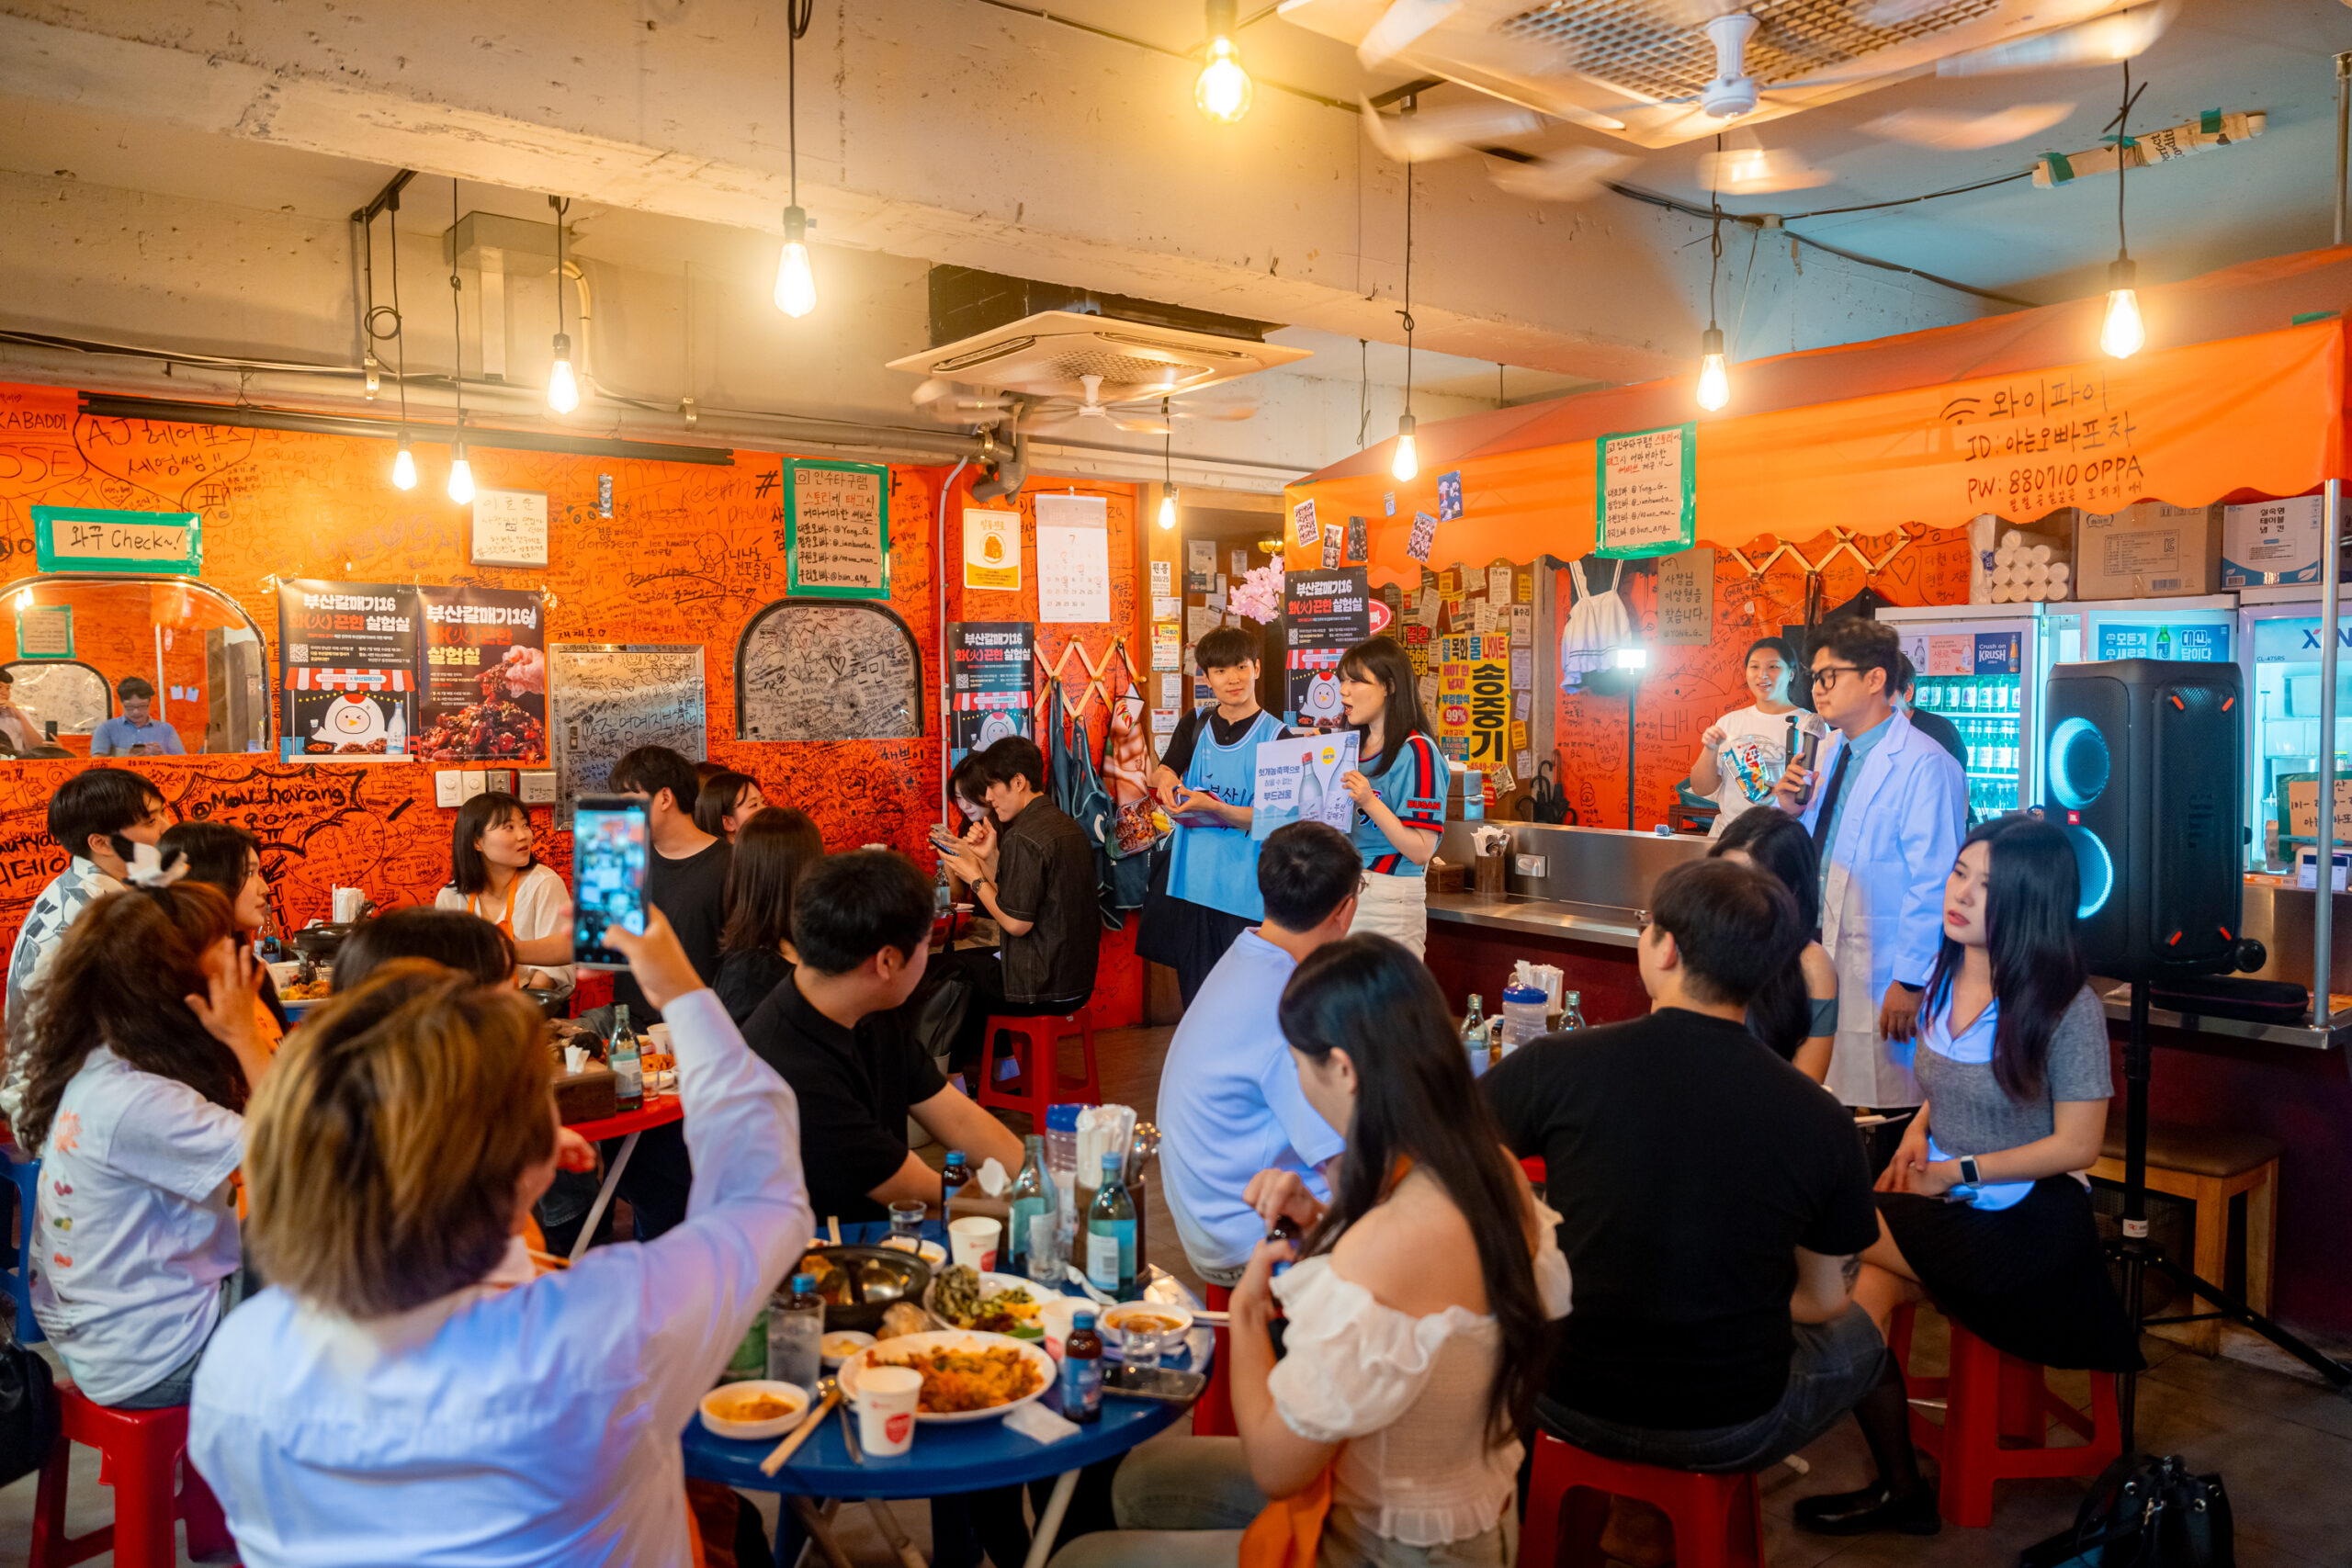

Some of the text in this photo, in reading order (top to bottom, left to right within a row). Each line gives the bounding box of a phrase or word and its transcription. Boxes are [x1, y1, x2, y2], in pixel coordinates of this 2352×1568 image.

[1989, 371, 2108, 418] 와이파이
[85, 418, 131, 448] AJ
[1965, 411, 2136, 461] ID: 아는오빠포차
[1968, 455, 2143, 504] PW: 880710 OPPA
[803, 491, 841, 507] 스토리에
[803, 508, 849, 521] 어마어마한
[735, 562, 772, 581] 전포술집
[1664, 571, 1694, 587] 사장님
[1296, 579, 1353, 597] 부산갈매기16
[303, 593, 397, 612] 부산갈매기16
[1332, 597, 1363, 613] 실험실
[366, 615, 411, 633] 실험실
[426, 604, 531, 626] 부산갈매기16
[1665, 606, 1703, 625] 찾습니다
[965, 633, 1023, 646] 부산갈매기16
[1482, 636, 1508, 661] 나이트
[2117, 633, 2147, 646] 모든게
[427, 647, 481, 665] 실험실
[1003, 648, 1031, 661] 실험실
[1978, 649, 2007, 662] KRUSH
[2181, 648, 2212, 660] 답이다
[1445, 708, 1467, 723] 99%
[1471, 663, 1506, 762] 송중기
[1407, 799, 1442, 810] BUSAN
